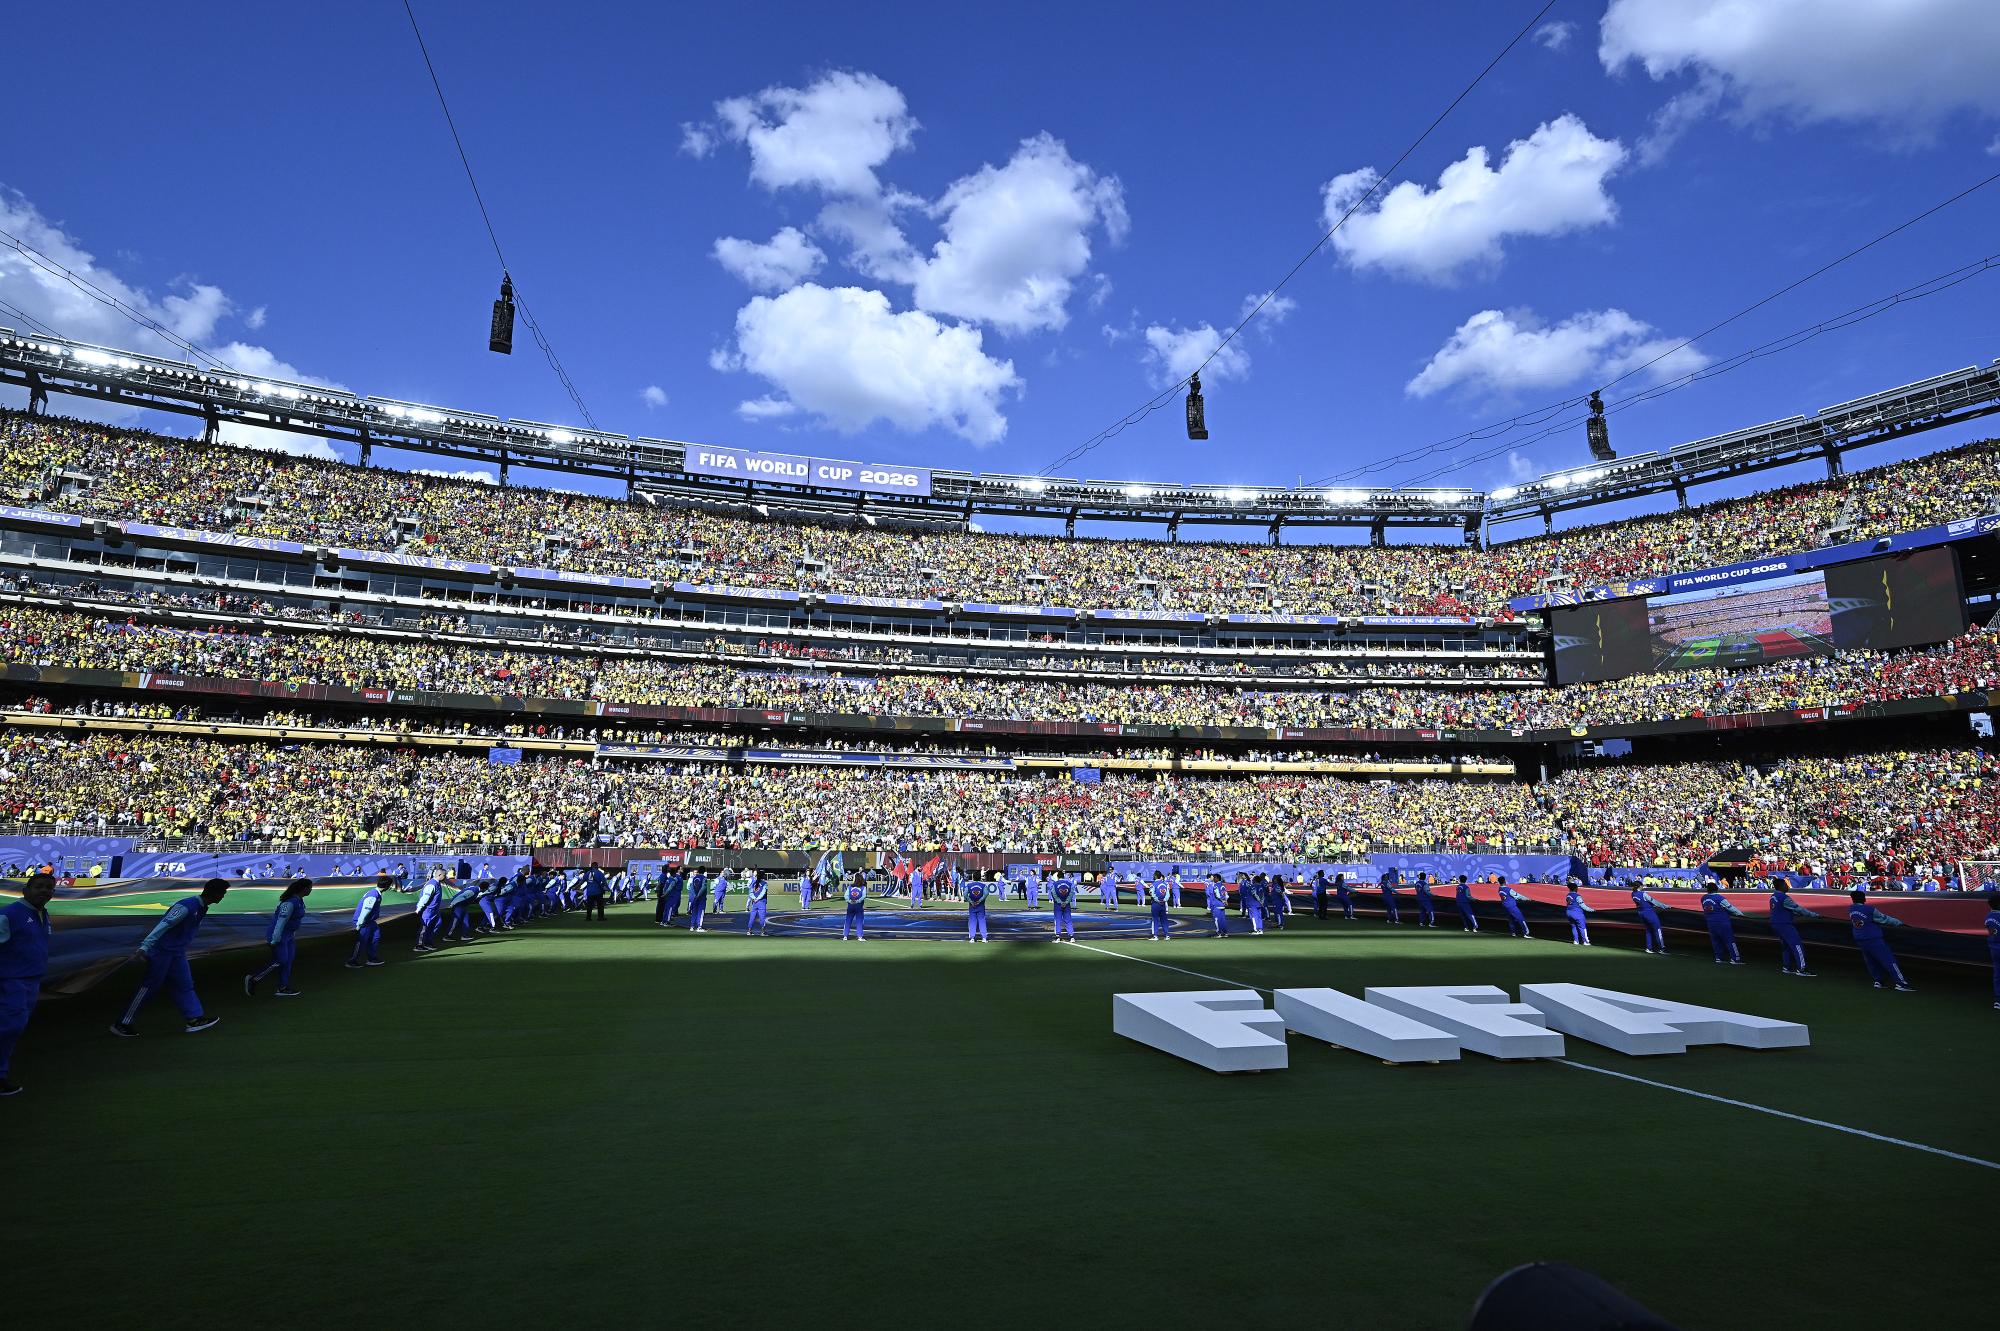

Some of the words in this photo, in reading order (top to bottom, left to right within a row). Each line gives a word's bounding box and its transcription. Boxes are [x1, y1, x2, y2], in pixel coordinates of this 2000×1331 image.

[699, 452, 738, 470] FIFA
[745, 457, 809, 477] WORLD
[818, 466, 853, 481] CUP
[859, 470, 919, 487] 2026
[11, 510, 72, 523] JERSEY
[1673, 577, 1694, 587] FIFA
[1694, 572, 1729, 584] WORLD
[1730, 568, 1751, 578] CUP
[1751, 562, 1788, 575] 2026
[155, 679, 185, 687] MOROCCO
[780, 752, 842, 760] #FIFAWorldCup
[1112, 982, 1811, 1074] FIFA
